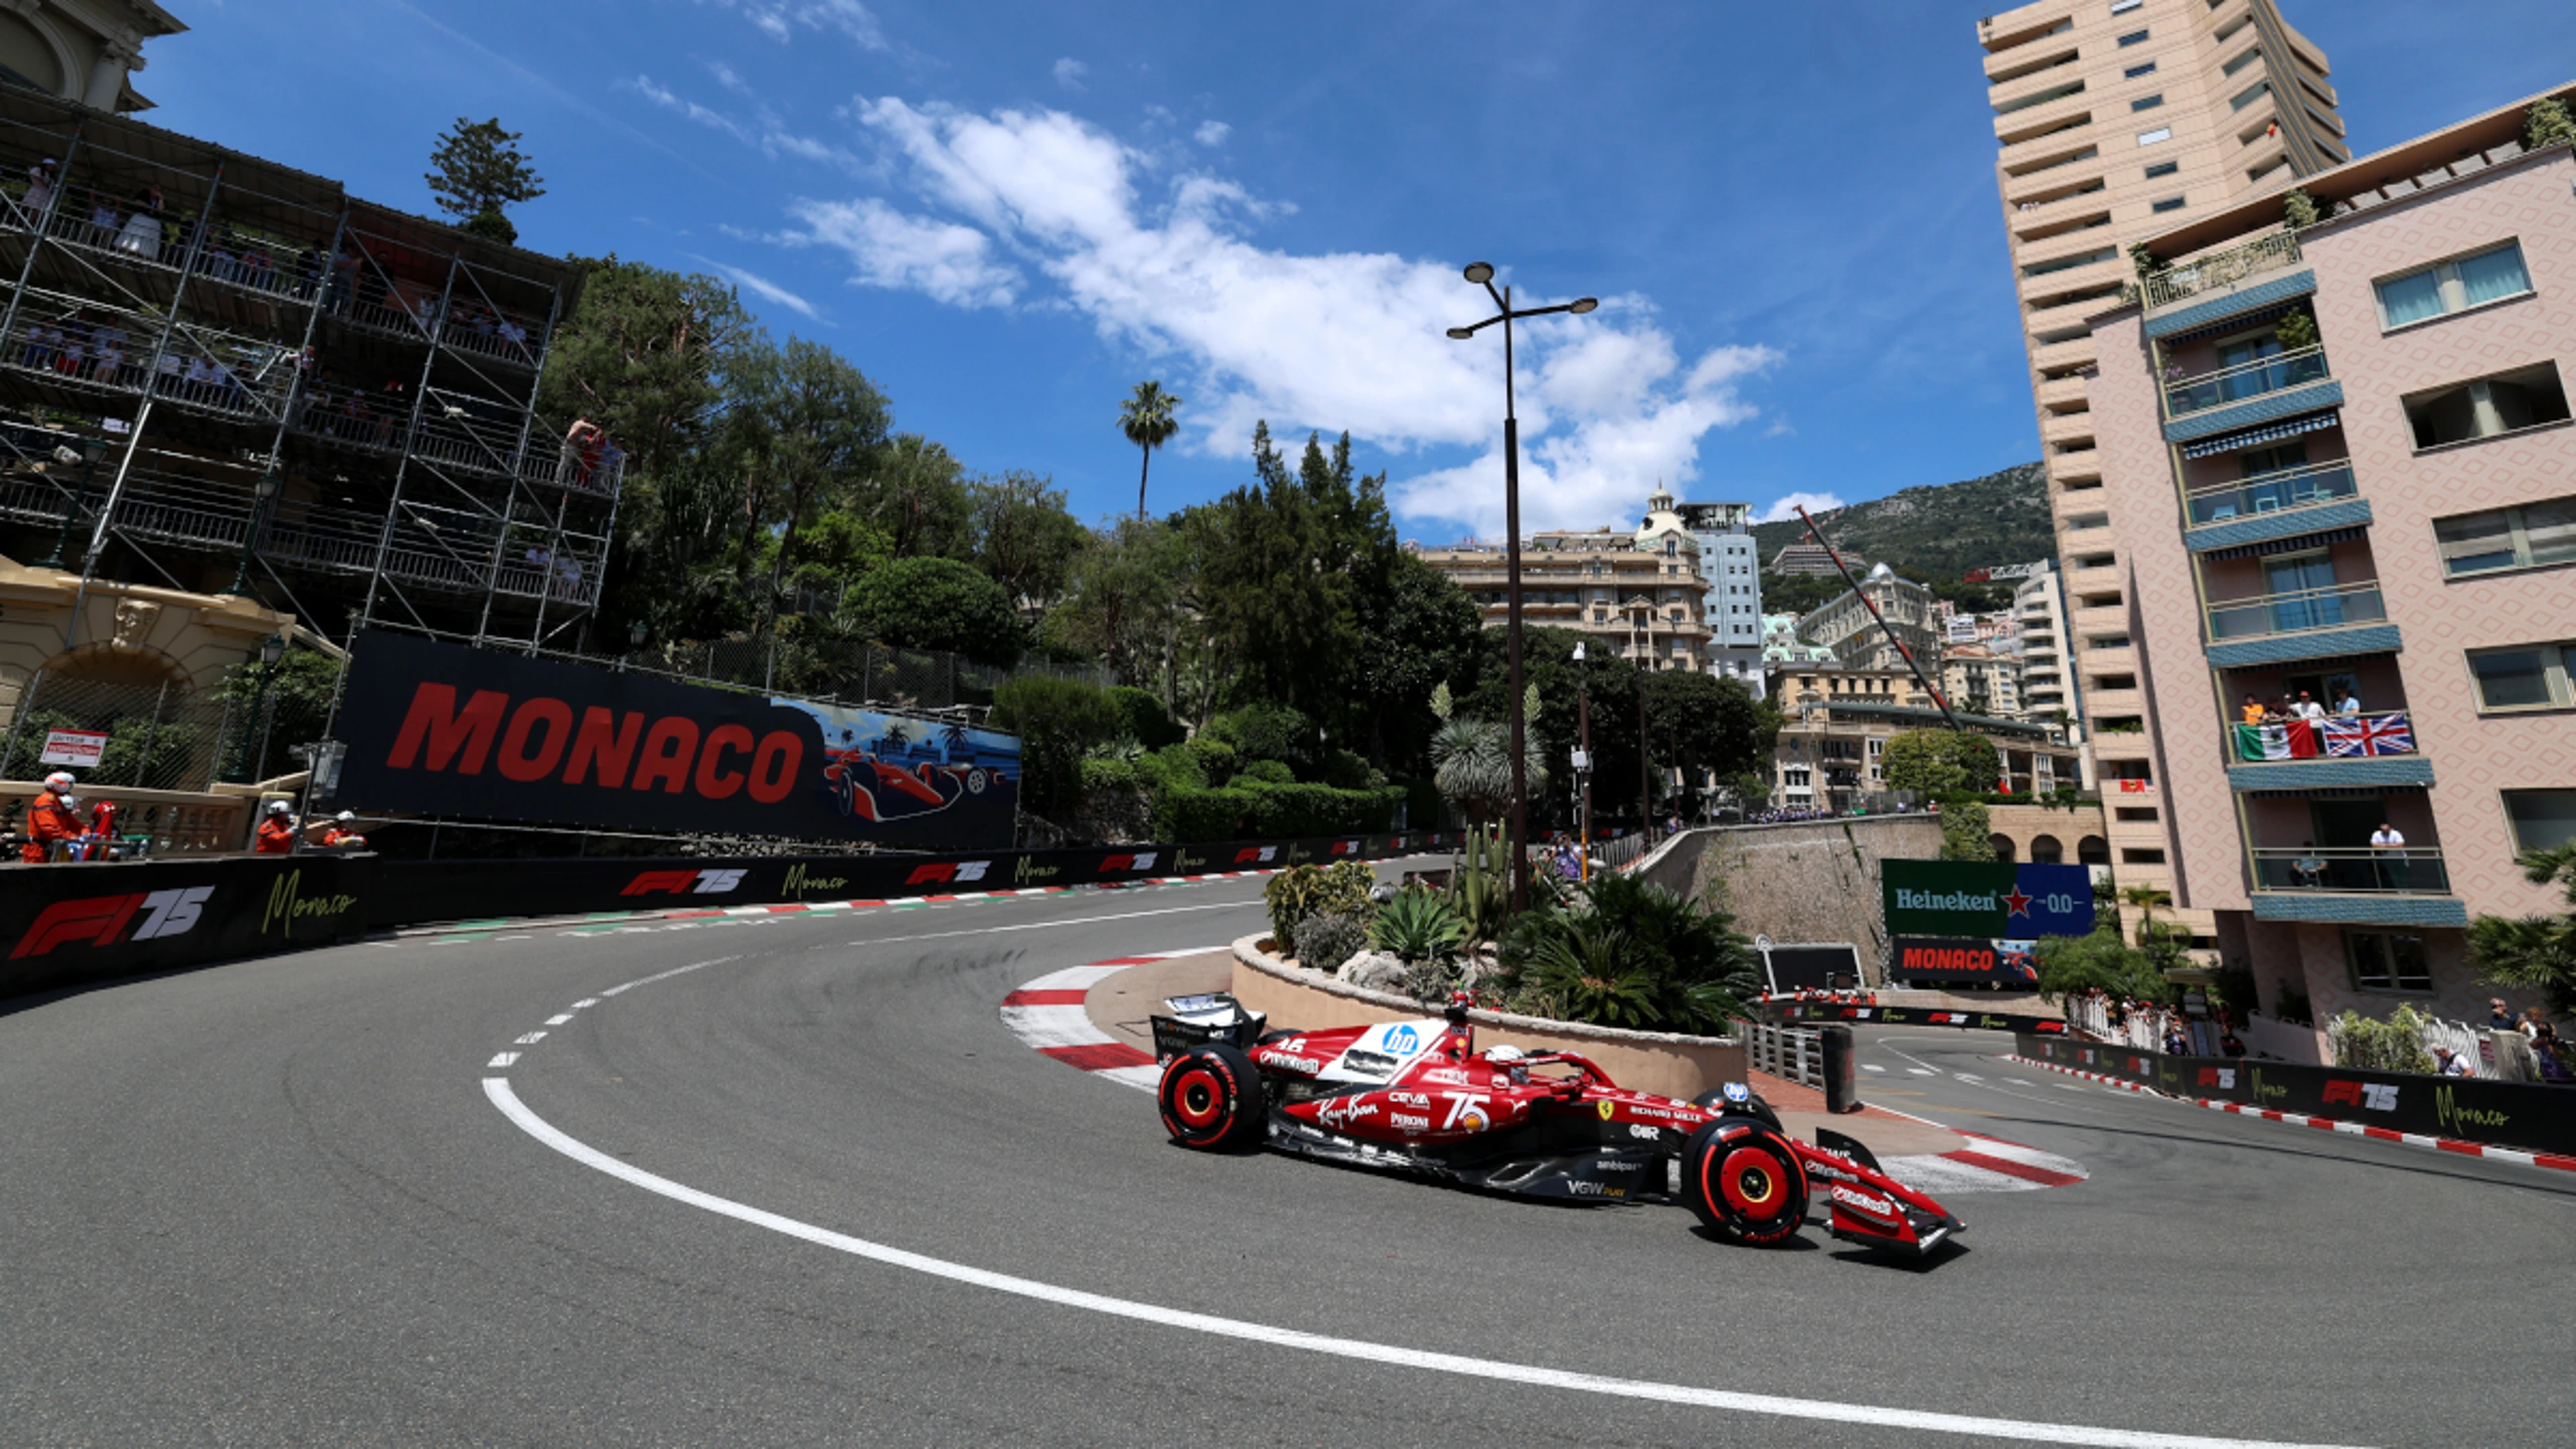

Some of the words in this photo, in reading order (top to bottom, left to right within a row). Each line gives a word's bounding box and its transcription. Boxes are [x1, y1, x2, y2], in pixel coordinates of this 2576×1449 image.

[386, 682, 804, 803] MONACO
[1098, 854, 1135, 872] F1
[1131, 852, 1158, 870] 75
[1234, 847, 1260, 863] F1
[1258, 846, 1277, 861] 75
[782, 863, 847, 899] Monaco
[905, 863, 958, 885] F1
[954, 861, 991, 881] 75
[1014, 855, 1060, 884] Monaco
[620, 869, 701, 896] F1
[693, 869, 748, 894] 75
[262, 869, 356, 938] Monaco
[1895, 888, 1997, 911] Heineken
[8, 892, 149, 960] F1
[130, 885, 215, 941] 75
[1902, 948, 1994, 971] MONACO
[1383, 1024, 1419, 1055] hp
[2198, 1067, 2218, 1087] F1
[2217, 1068, 2235, 1089] 75
[1389, 1092, 1432, 1104] CEVA
[2322, 1079, 2363, 1107] F1
[2360, 1083, 2400, 1112] 75
[1391, 1112, 1430, 1128] PERONI
[1629, 1106, 1671, 1119] RICHARD
[1673, 1110, 1703, 1124] MILLE
[2435, 1085, 2511, 1135] Monaco
[1567, 1179, 1605, 1195] VGW
